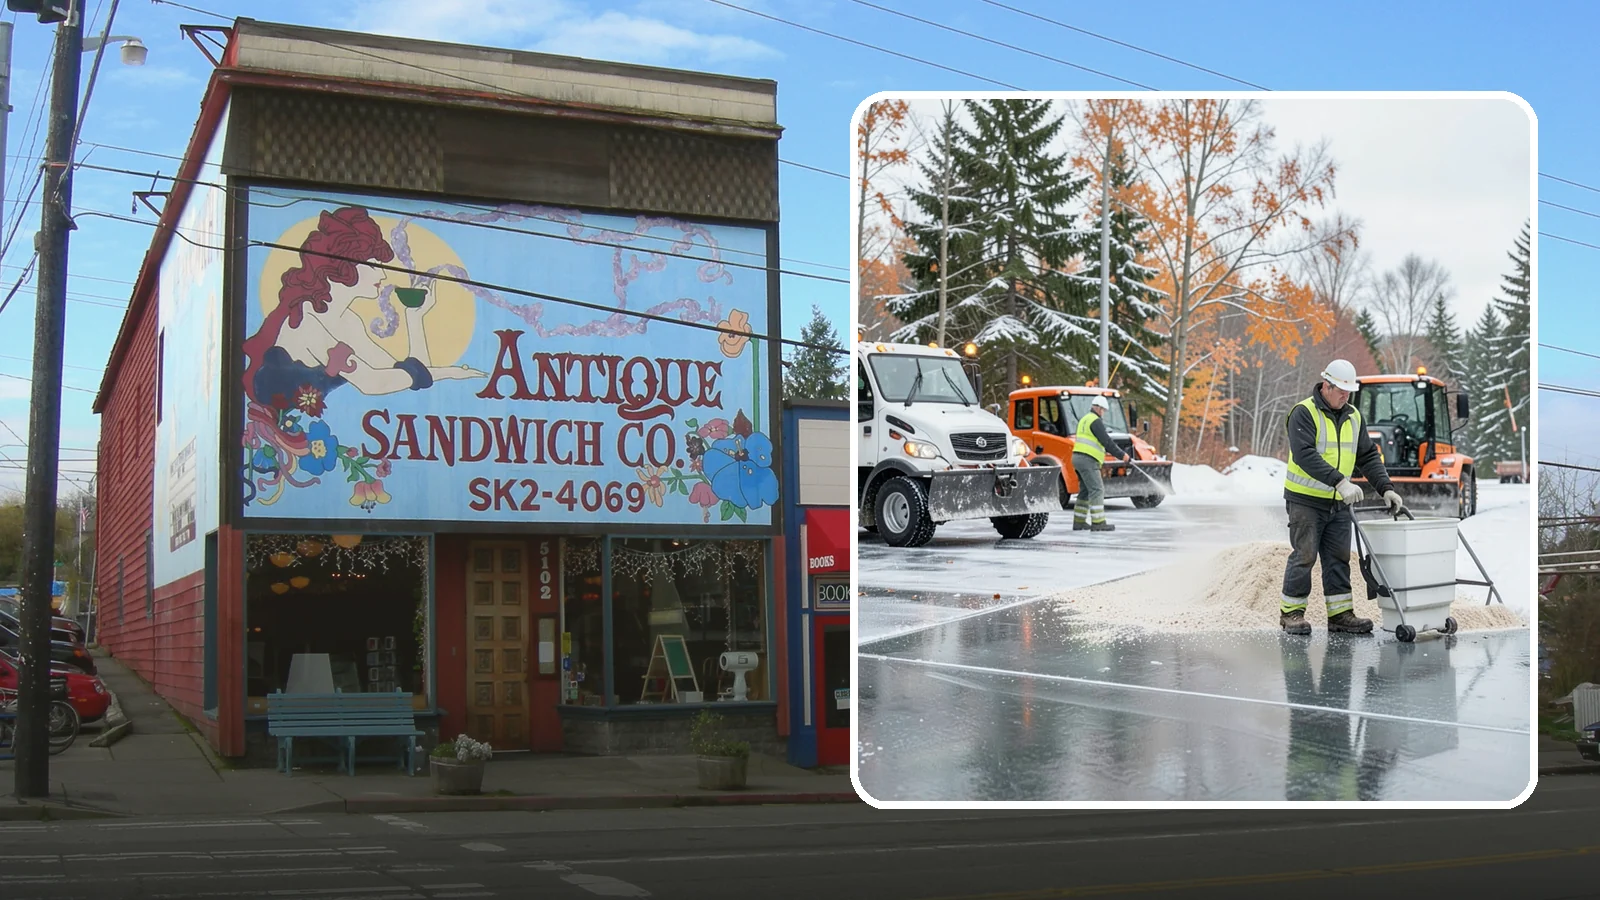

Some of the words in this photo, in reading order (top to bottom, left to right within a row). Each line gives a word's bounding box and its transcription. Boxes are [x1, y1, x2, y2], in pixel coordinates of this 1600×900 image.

[475, 329, 724, 421] ANTIQUE
[361, 409, 604, 467] SANDWICH
[617, 422, 685, 468] CO.
[468, 477, 645, 513] SK2-4069
[540, 541, 552, 600] 5102
[809, 555, 835, 569] BOOKS
